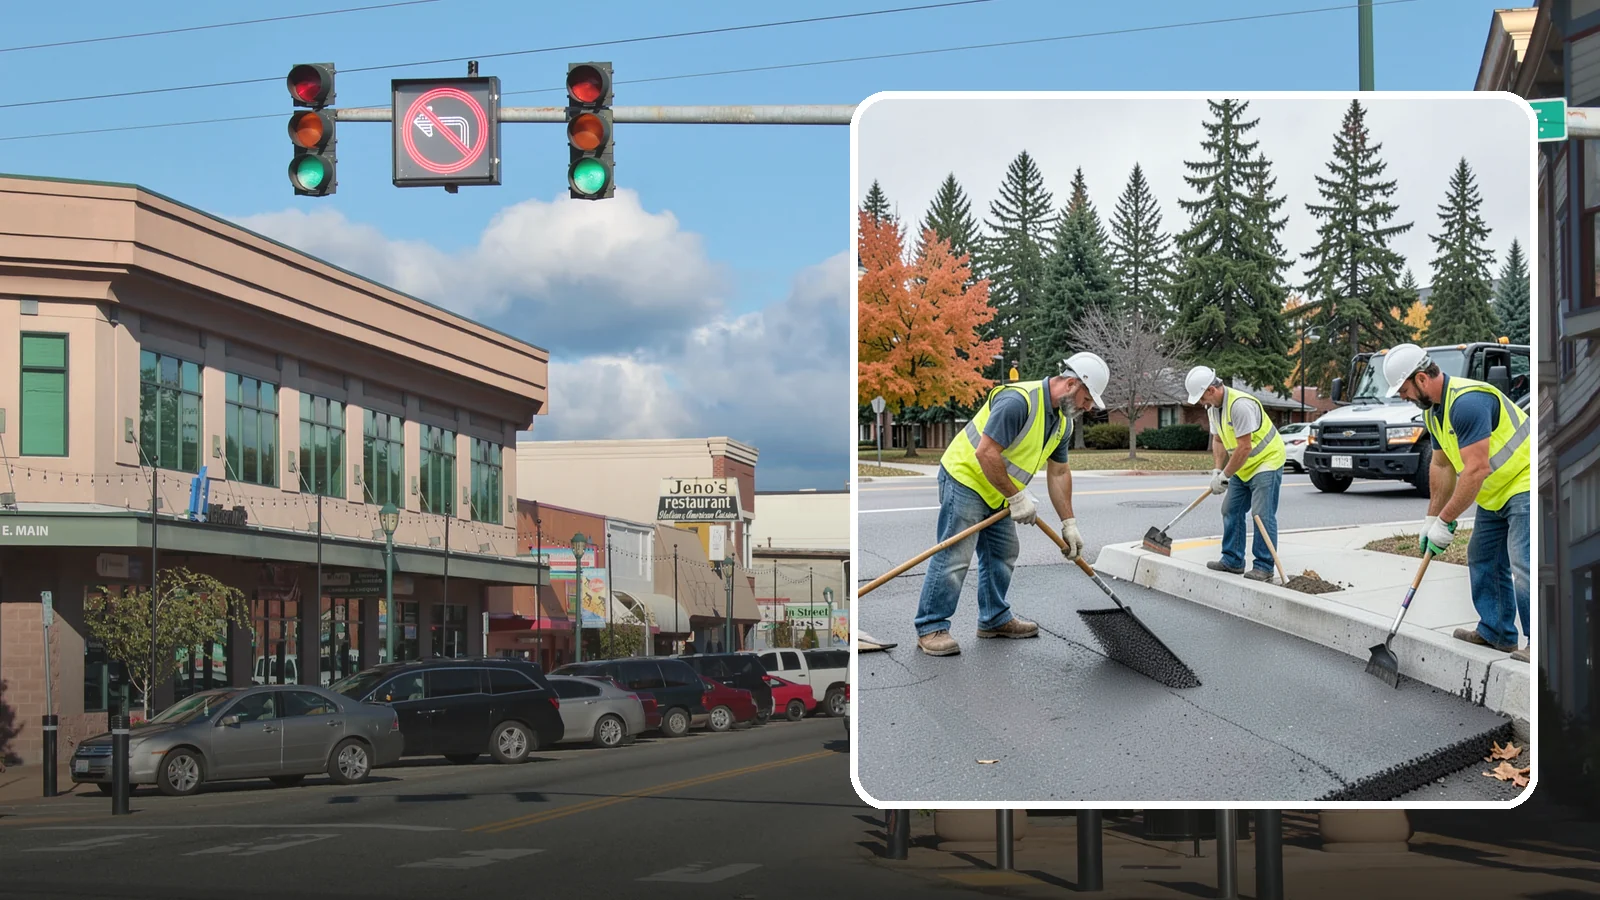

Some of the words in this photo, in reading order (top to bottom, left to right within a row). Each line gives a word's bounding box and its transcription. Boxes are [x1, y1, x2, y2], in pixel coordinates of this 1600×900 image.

[670, 480, 727, 494] Jeno's
[665, 496, 731, 509] restaurant
[659, 510, 681, 519] Italian
[686, 510, 714, 519] American
[715, 510, 737, 519] Cuisine
[2, 525, 13, 536] E.
[15, 525, 49, 536] MAIN
[797, 608, 828, 616] Street
